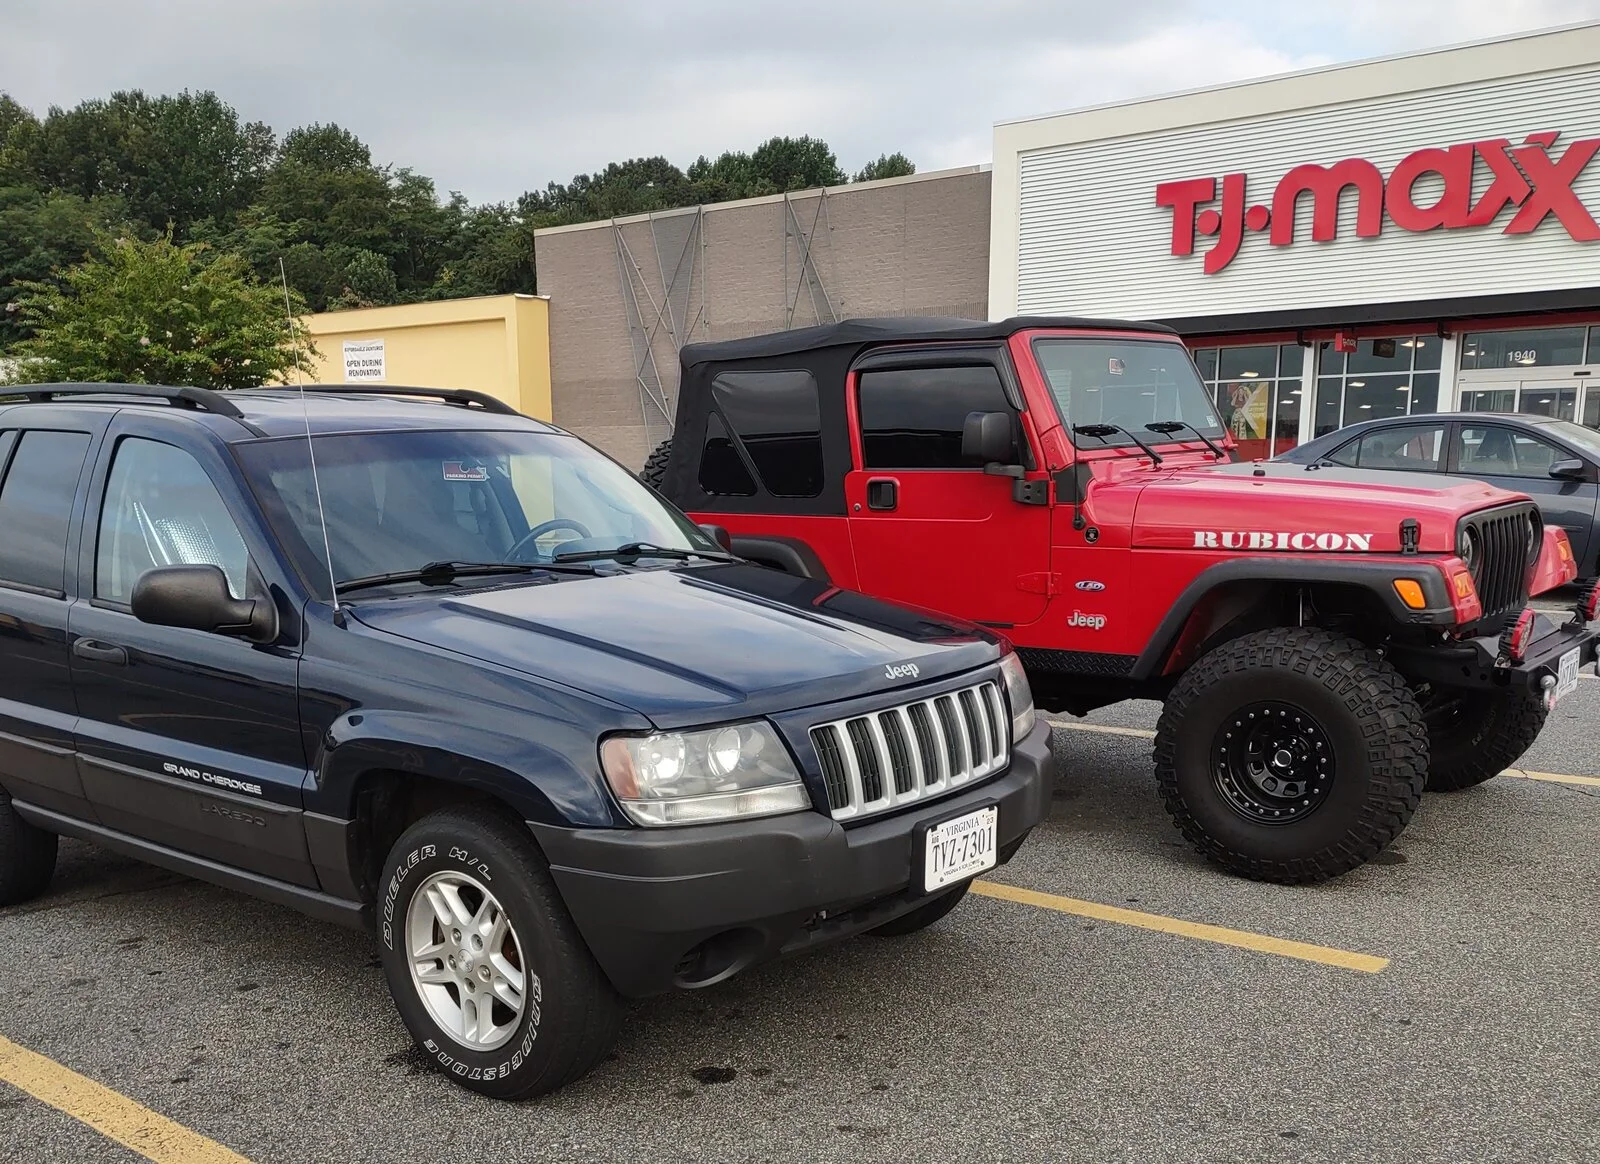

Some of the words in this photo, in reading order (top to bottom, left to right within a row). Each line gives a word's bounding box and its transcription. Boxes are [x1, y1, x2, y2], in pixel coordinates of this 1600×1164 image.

[361, 359, 382, 367] DURING
[1507, 350, 1537, 362] 1940
[348, 369, 382, 377] RENOVATION
[1193, 531, 1374, 551] RUBICON
[1067, 610, 1106, 630] Jeep
[884, 663, 920, 680] Jeep
[163, 762, 201, 779] GRAND
[202, 772, 263, 795] CHEROKEE
[945, 816, 980, 837] VIRGINIA
[383, 845, 437, 951] DUELER
[423, 969, 543, 1082] BRIDGESTONE
